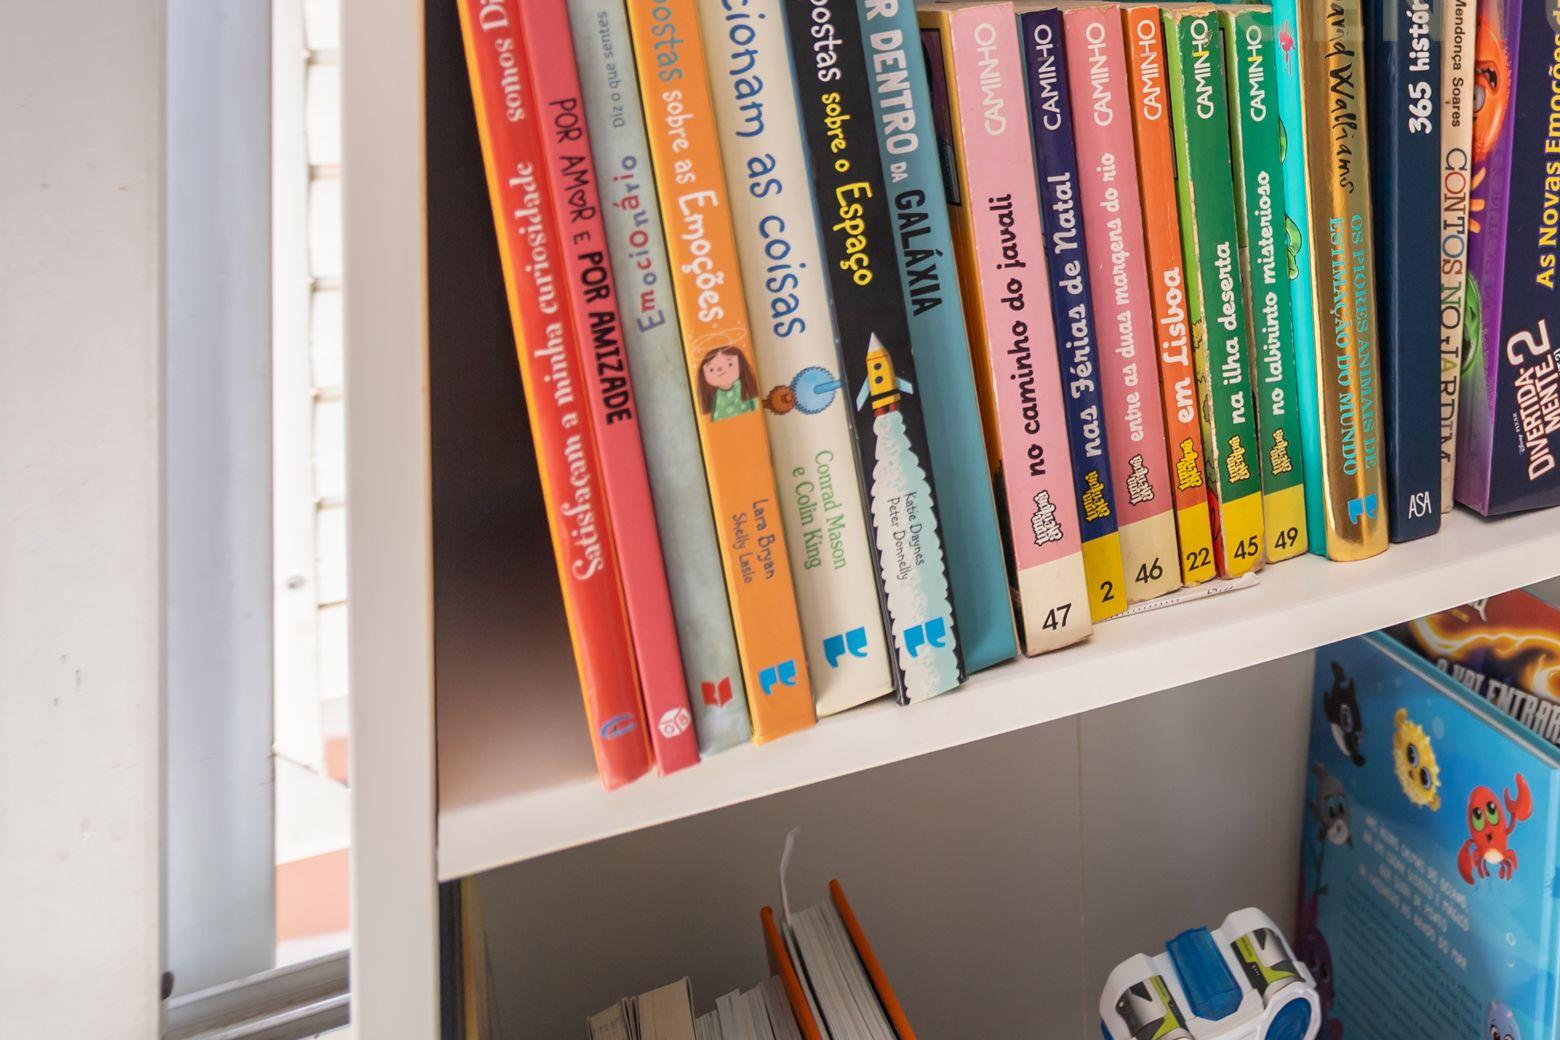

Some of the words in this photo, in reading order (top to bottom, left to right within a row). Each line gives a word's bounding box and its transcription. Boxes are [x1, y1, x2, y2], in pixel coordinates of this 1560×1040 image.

[598, 10, 613, 59] sentes
[495, 38, 525, 123] somos
[605, 62, 621, 89] que
[974, 23, 1006, 136] CAMINHO
[1034, 24, 1061, 131] CAMINHO
[1086, 22, 1113, 127] CAMINHO
[1137, 19, 1161, 121] CAMINHO
[1190, 19, 1214, 119] CAMINHO
[1246, 26, 1266, 122] CAMINHO
[549, 98, 582, 144] POR
[613, 105, 624, 128] Diz
[662, 89, 690, 152] sobre
[821, 92, 848, 153] sobre
[1328, 62, 1355, 194] Walliams
[1406, 81, 1432, 134] 365
[1451, 76, 1464, 128] Soares
[675, 157, 696, 184] as
[747, 152, 783, 198] as
[870, 29, 919, 157] DENTRO
[895, 189, 943, 317] GALÁXIA
[1096, 153, 1117, 183] rio
[832, 182, 873, 286] Espaço
[989, 193, 1026, 271] javali
[1047, 171, 1078, 254] Natal
[1248, 171, 1276, 284] misterioso
[1351, 214, 1364, 243] OS
[1442, 148, 1467, 275] CONTOS
[510, 162, 558, 316] curiosidade
[613, 155, 665, 333] Emocionário
[678, 190, 724, 323] Emoções
[1104, 217, 1132, 305] margens
[580, 251, 610, 303] POR
[758, 214, 806, 338] coisas
[1000, 279, 1024, 312] do
[1059, 261, 1083, 295] de
[1215, 241, 1239, 334] deserta
[1329, 218, 1353, 348] ESTIMAÇÃO
[1352, 252, 1369, 333] PIORES
[1536, 257, 1554, 289] As
[1159, 266, 1188, 367] Lisboa
[1441, 283, 1461, 330] NO
[1064, 302, 1098, 400] Férias
[1115, 310, 1136, 358] duas
[1259, 291, 1283, 382] labirinto
[1506, 318, 1550, 366] 2
[535, 322, 574, 407] minha
[586, 311, 632, 425] AMIZADE
[1007, 321, 1040, 435] caminho
[1222, 337, 1242, 387] ilha
[1337, 355, 1353, 387] DO
[1358, 339, 1374, 432] ANIMAIS
[1124, 389, 1144, 442] entre
[1177, 376, 1195, 424] em
[1230, 391, 1246, 425] na
[1270, 387, 1285, 416] no
[1514, 368, 1555, 480] DIVERTIDA-
[1078, 405, 1102, 457] nas
[1339, 393, 1359, 476] MUNDO
[1363, 437, 1377, 469] DE
[815, 450, 841, 512] Conrad
[1020, 444, 1046, 476] no
[564, 435, 604, 582] Satisfaçam
[752, 498, 768, 531] Lara
[795, 481, 817, 526] Colin
[888, 497, 901, 528] Peter
[903, 492, 918, 522] Katie
[1408, 491, 1432, 519] ASA
[733, 512, 748, 549] Shelly
[804, 529, 823, 570] King
[827, 514, 846, 569] Mason
[893, 530, 909, 580] Donnelly
[910, 524, 924, 565] Daynes
[1233, 535, 1259, 561] 45
[1274, 526, 1298, 551] 49
[757, 535, 775, 580] Bryan
[1135, 558, 1164, 584] 46
[1186, 547, 1211, 572] 22
[1100, 580, 1114, 603] 2
[1042, 604, 1072, 632] 47
